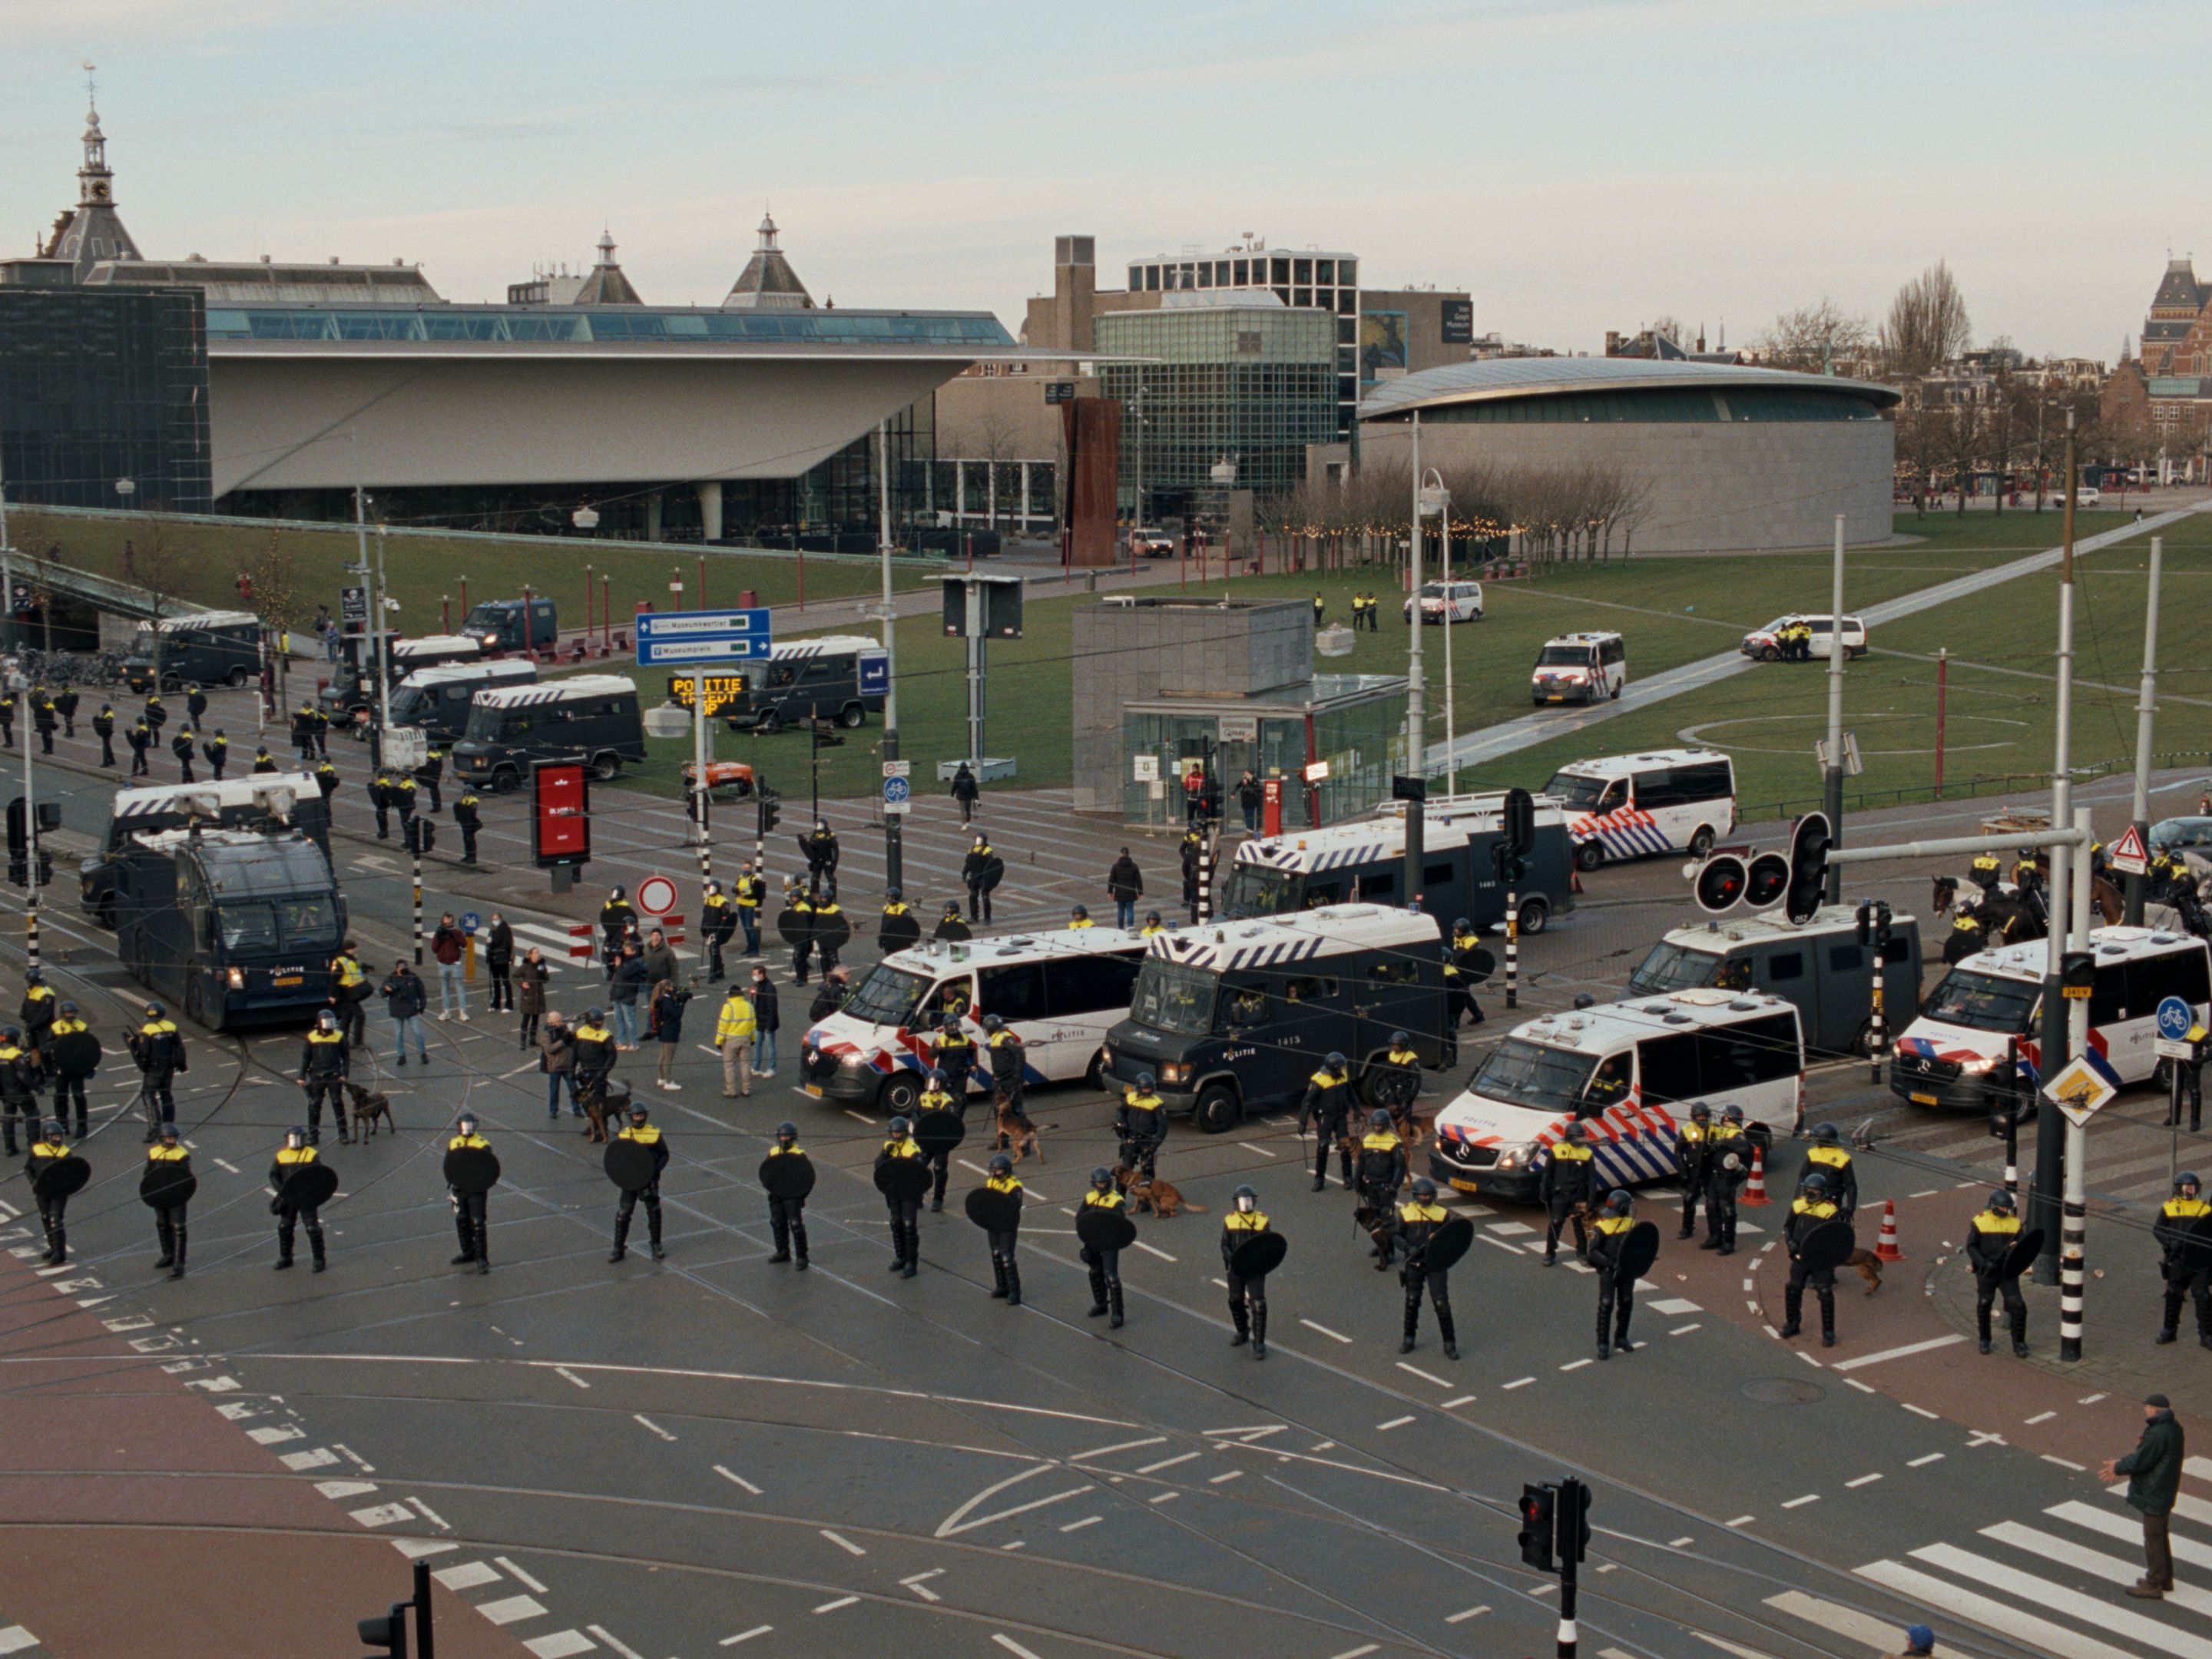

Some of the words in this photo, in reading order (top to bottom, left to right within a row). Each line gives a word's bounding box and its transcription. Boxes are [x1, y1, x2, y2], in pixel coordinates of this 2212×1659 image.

[671, 620, 727, 629] Museumkwartier
[663, 646, 711, 654] Museumplein
[674, 679, 742, 692] POITIE
[270, 965, 304, 976] POLITIE
[1222, 1048, 1256, 1061] POLITIE
